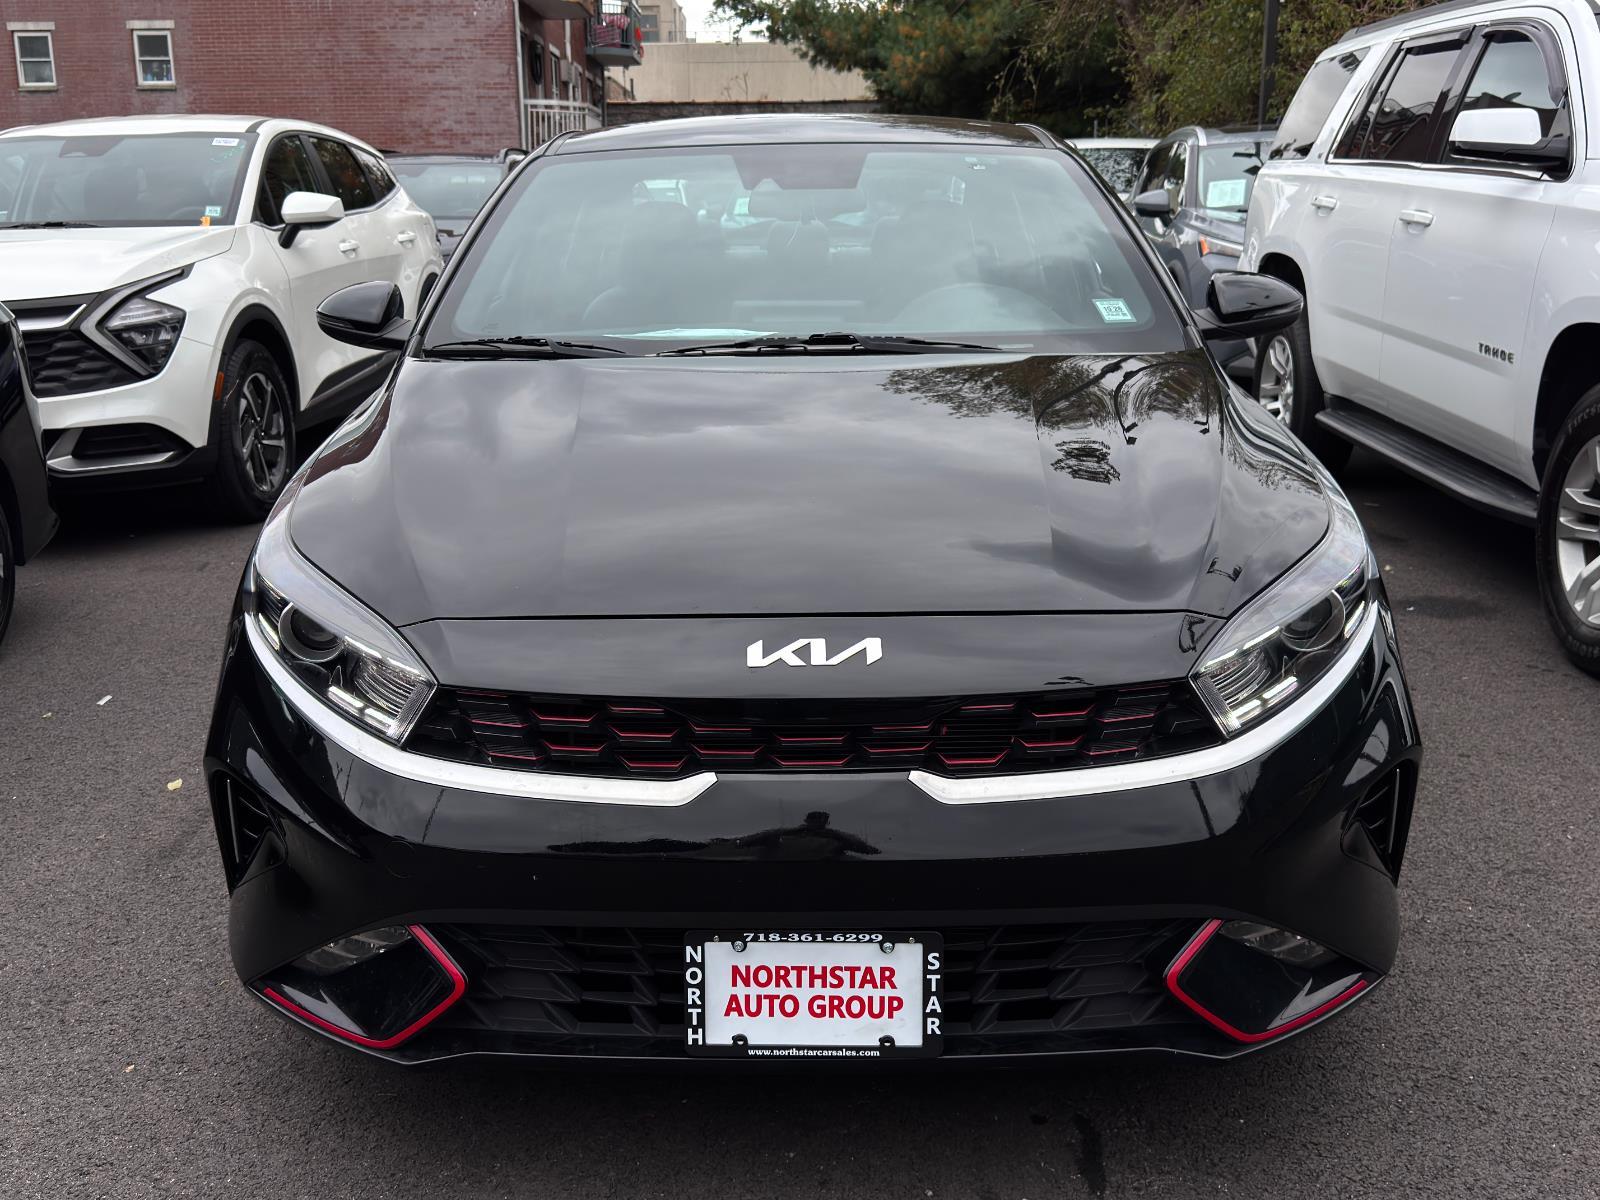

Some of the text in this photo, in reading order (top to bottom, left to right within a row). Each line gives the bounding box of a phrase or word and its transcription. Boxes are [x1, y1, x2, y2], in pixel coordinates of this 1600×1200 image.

[1478, 342, 1515, 365] TAHOE
[747, 637, 882, 667] KIA
[743, 932, 884, 943] 718-361-6299
[731, 965, 897, 989] NORTHSTAR
[685, 945, 703, 1046] NORTH
[926, 952, 942, 1035] STAR
[724, 994, 904, 1020] AUTO GROUP
[747, 1047, 880, 1057] www.northstarcarsales.com
